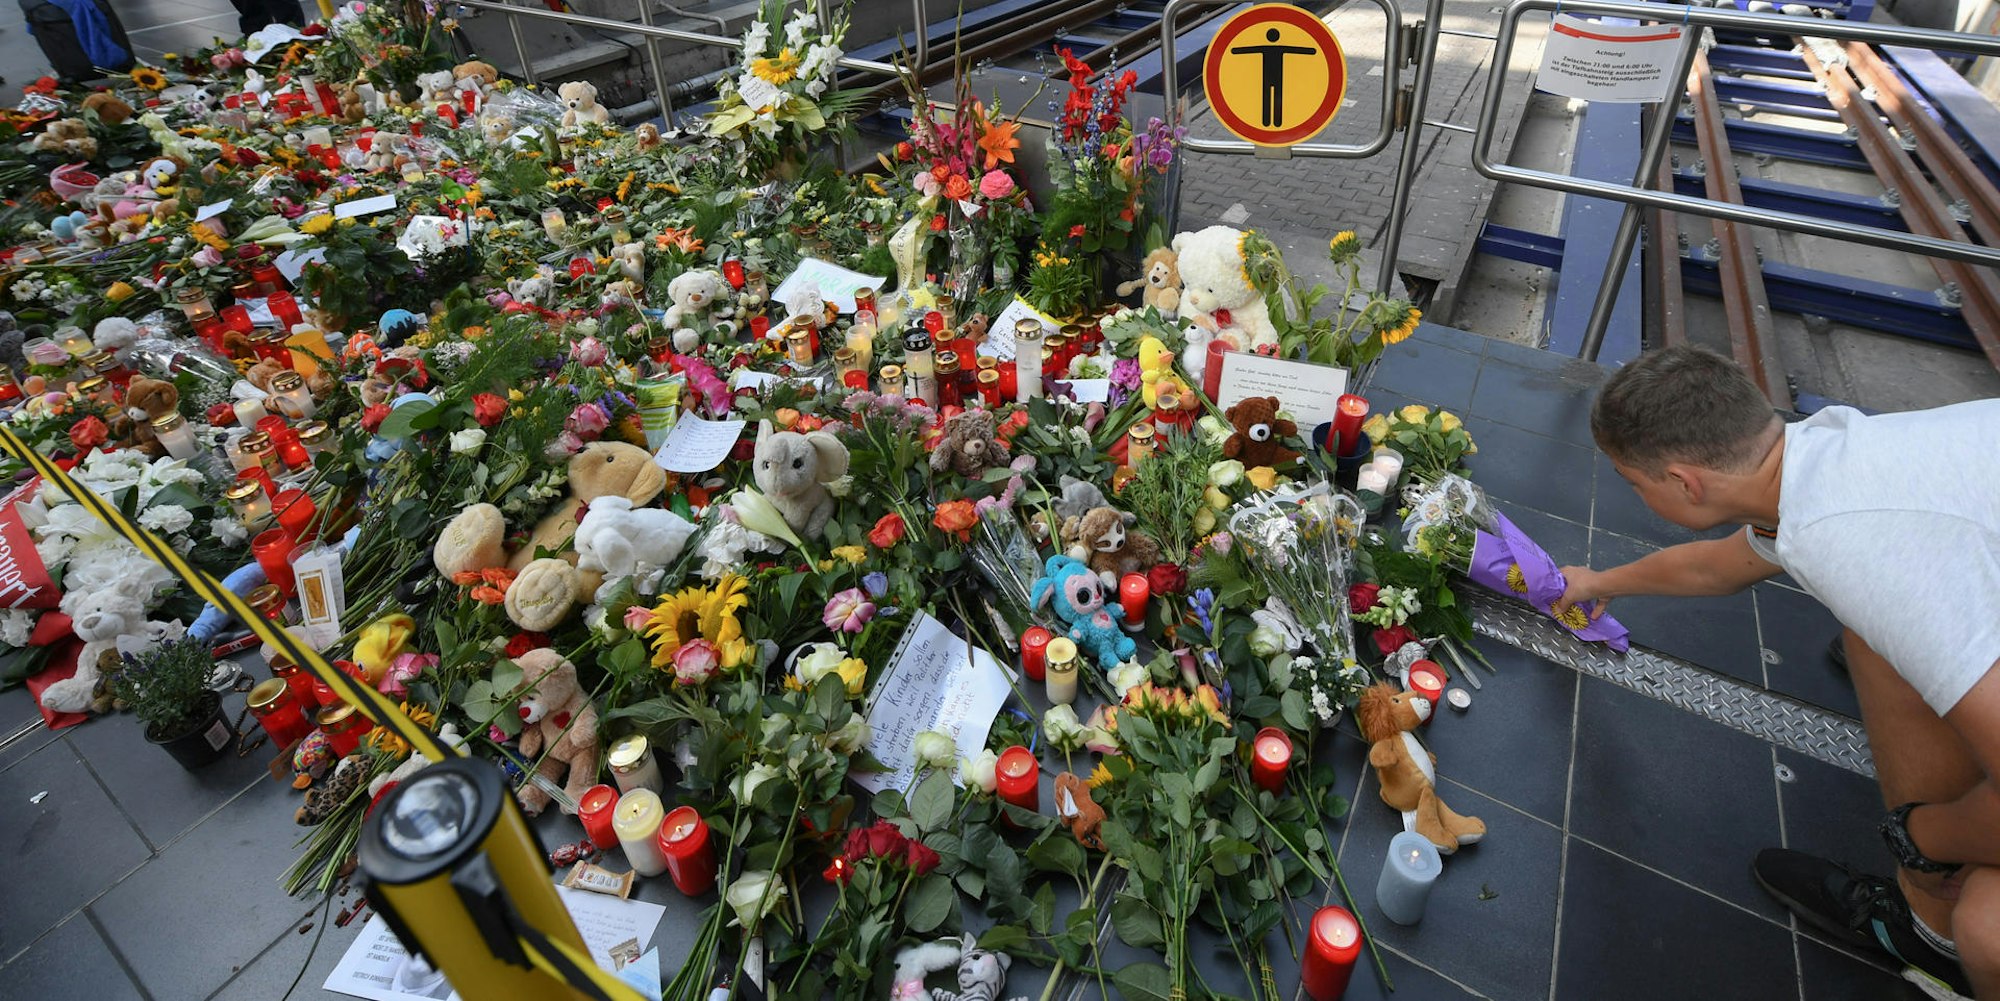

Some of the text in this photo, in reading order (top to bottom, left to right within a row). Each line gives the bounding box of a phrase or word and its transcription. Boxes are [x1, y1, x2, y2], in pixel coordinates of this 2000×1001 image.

[1562, 55, 1592, 67] Zwischen
[1595, 49, 1626, 58] Achtung!
[1560, 60, 1571, 68] der
[1572, 64, 1614, 76] Tiefbahnsteig
[1615, 68, 1661, 76] ausschließlich
[869, 639, 930, 749] Viele Kinder sollen
[906, 685, 920, 707] weil
[899, 726, 916, 753] dafür
[930, 665, 945, 685] dass
